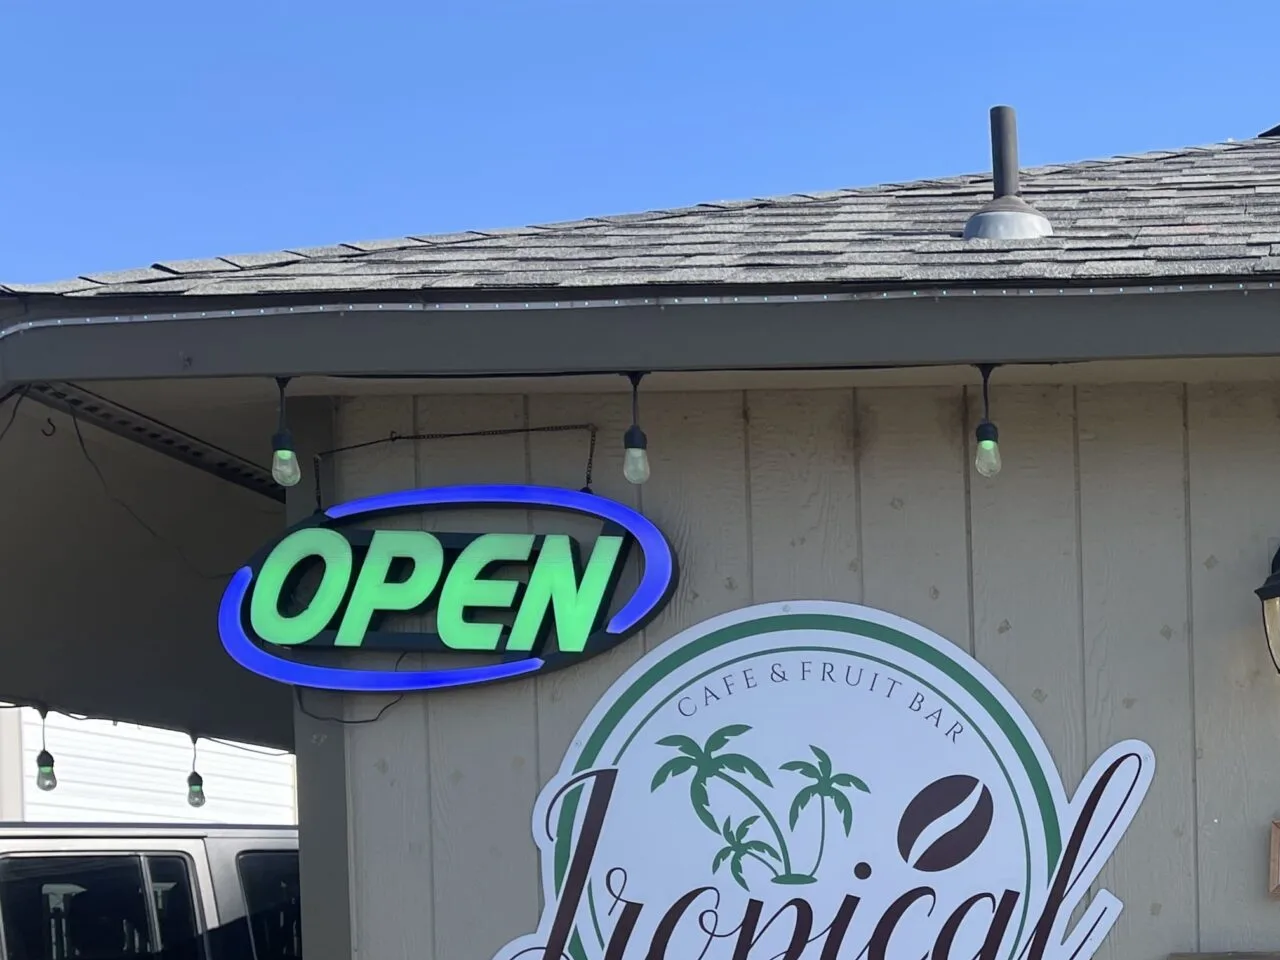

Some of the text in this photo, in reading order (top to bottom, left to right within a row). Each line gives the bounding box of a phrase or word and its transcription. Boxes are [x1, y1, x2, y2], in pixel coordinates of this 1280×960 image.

[251, 527, 623, 652] OPEN
[677, 661, 963, 744] CAFE & FRUIT BAR
